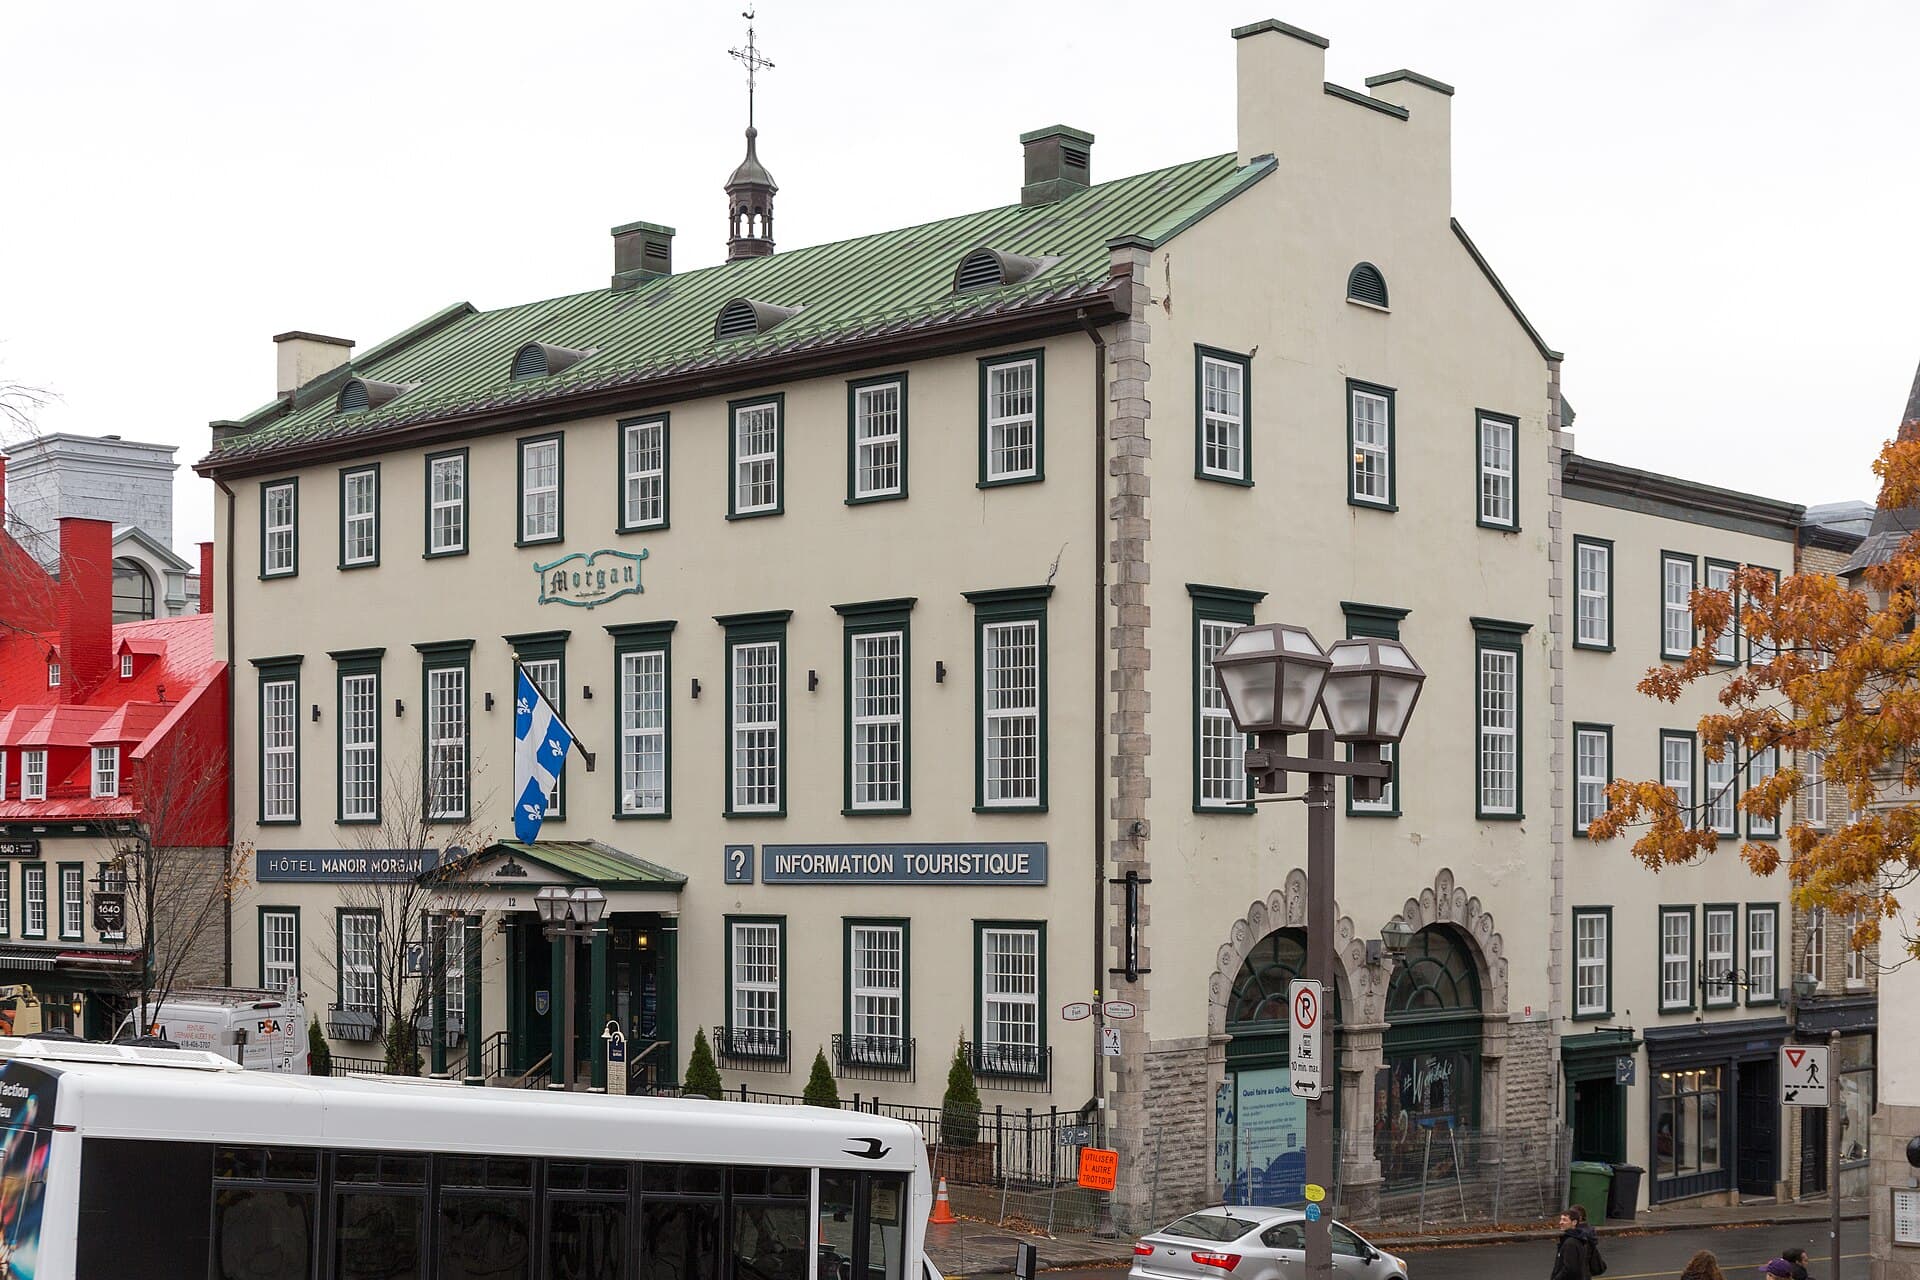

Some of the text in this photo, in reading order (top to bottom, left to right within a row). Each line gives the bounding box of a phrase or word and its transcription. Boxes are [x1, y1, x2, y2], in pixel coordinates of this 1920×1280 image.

[549, 566, 633, 595] Morgan
[269, 856, 423, 873] HÔTEL MANOIR MORGAN
[775, 853, 1030, 875] INFORMATION TOURISTIQUE
[508, 897, 516, 907] 12
[97, 904, 121, 914] 1640
[257, 1018, 281, 1035] PSA
[1291, 1061, 1298, 1071] 10
[1242, 1089, 1256, 1097] Quoi
[1256, 1087, 1268, 1096] faire
[1085, 1153, 1115, 1165] UTILISER
[1082, 1174, 1113, 1186] TROTTOIR
